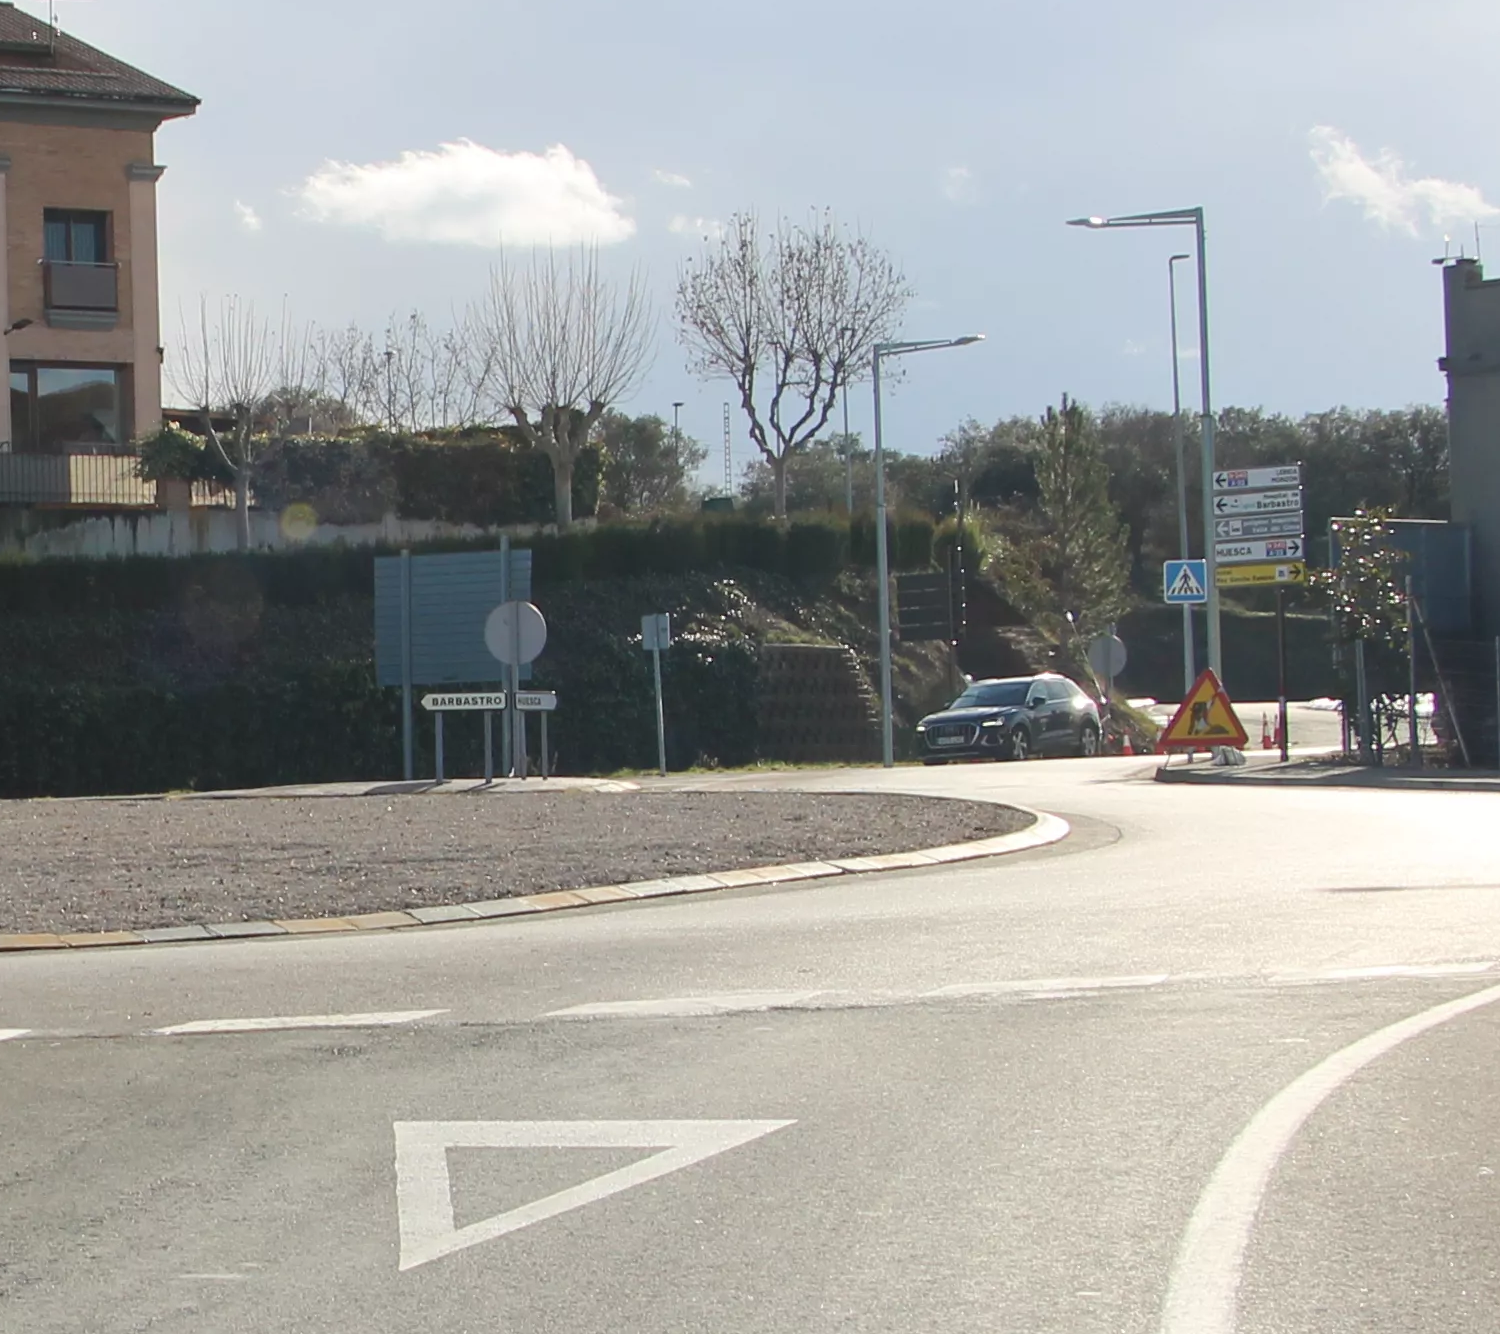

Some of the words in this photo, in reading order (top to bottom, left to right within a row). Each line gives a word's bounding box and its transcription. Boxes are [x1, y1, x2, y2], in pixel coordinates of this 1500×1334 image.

[1256, 499, 1299, 509] Barbastro
[1216, 547, 1252, 557] HUESCA
[431, 696, 502, 706] BARBASTRO
